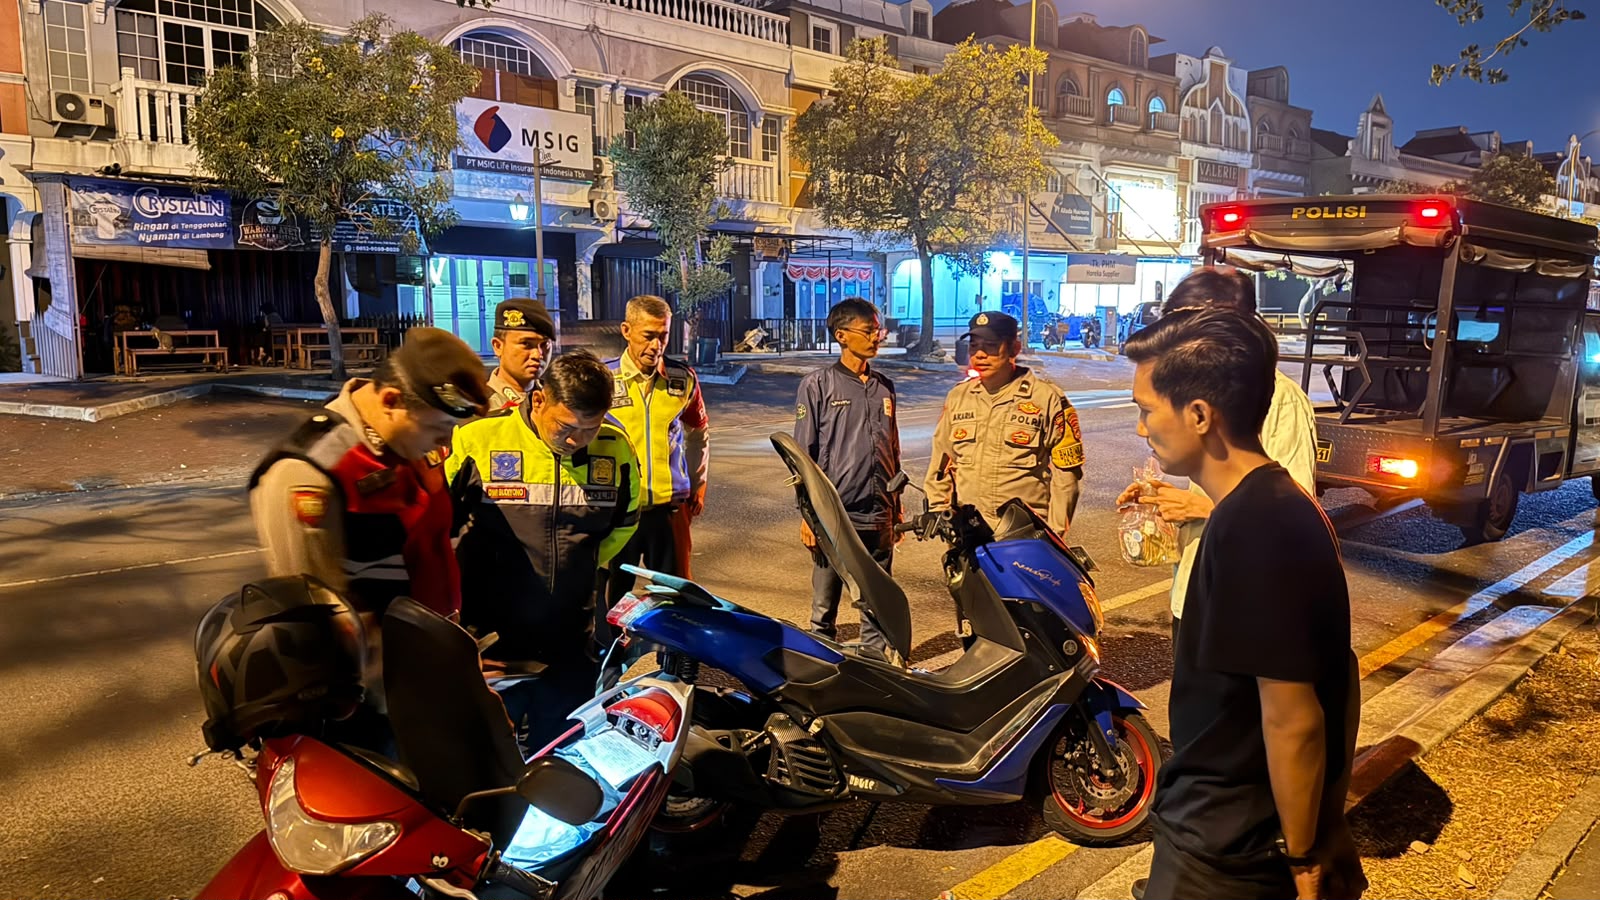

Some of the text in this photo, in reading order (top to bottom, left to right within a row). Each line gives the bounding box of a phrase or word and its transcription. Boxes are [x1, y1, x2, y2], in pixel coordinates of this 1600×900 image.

[521, 128, 578, 153] MSIG
[466, 158, 586, 178] PT MSIG Life Insurane Indonesia Tbk
[1199, 162, 1238, 179] VALERIE
[133, 187, 224, 218] CRYSTALIN
[370, 203, 404, 216] ATET
[1291, 206, 1366, 219] POLISI
[133, 222, 169, 231] Ringan
[181, 222, 227, 230] Tenggorokan
[138, 232, 180, 242] Nyaman
[191, 232, 224, 240] Lambung
